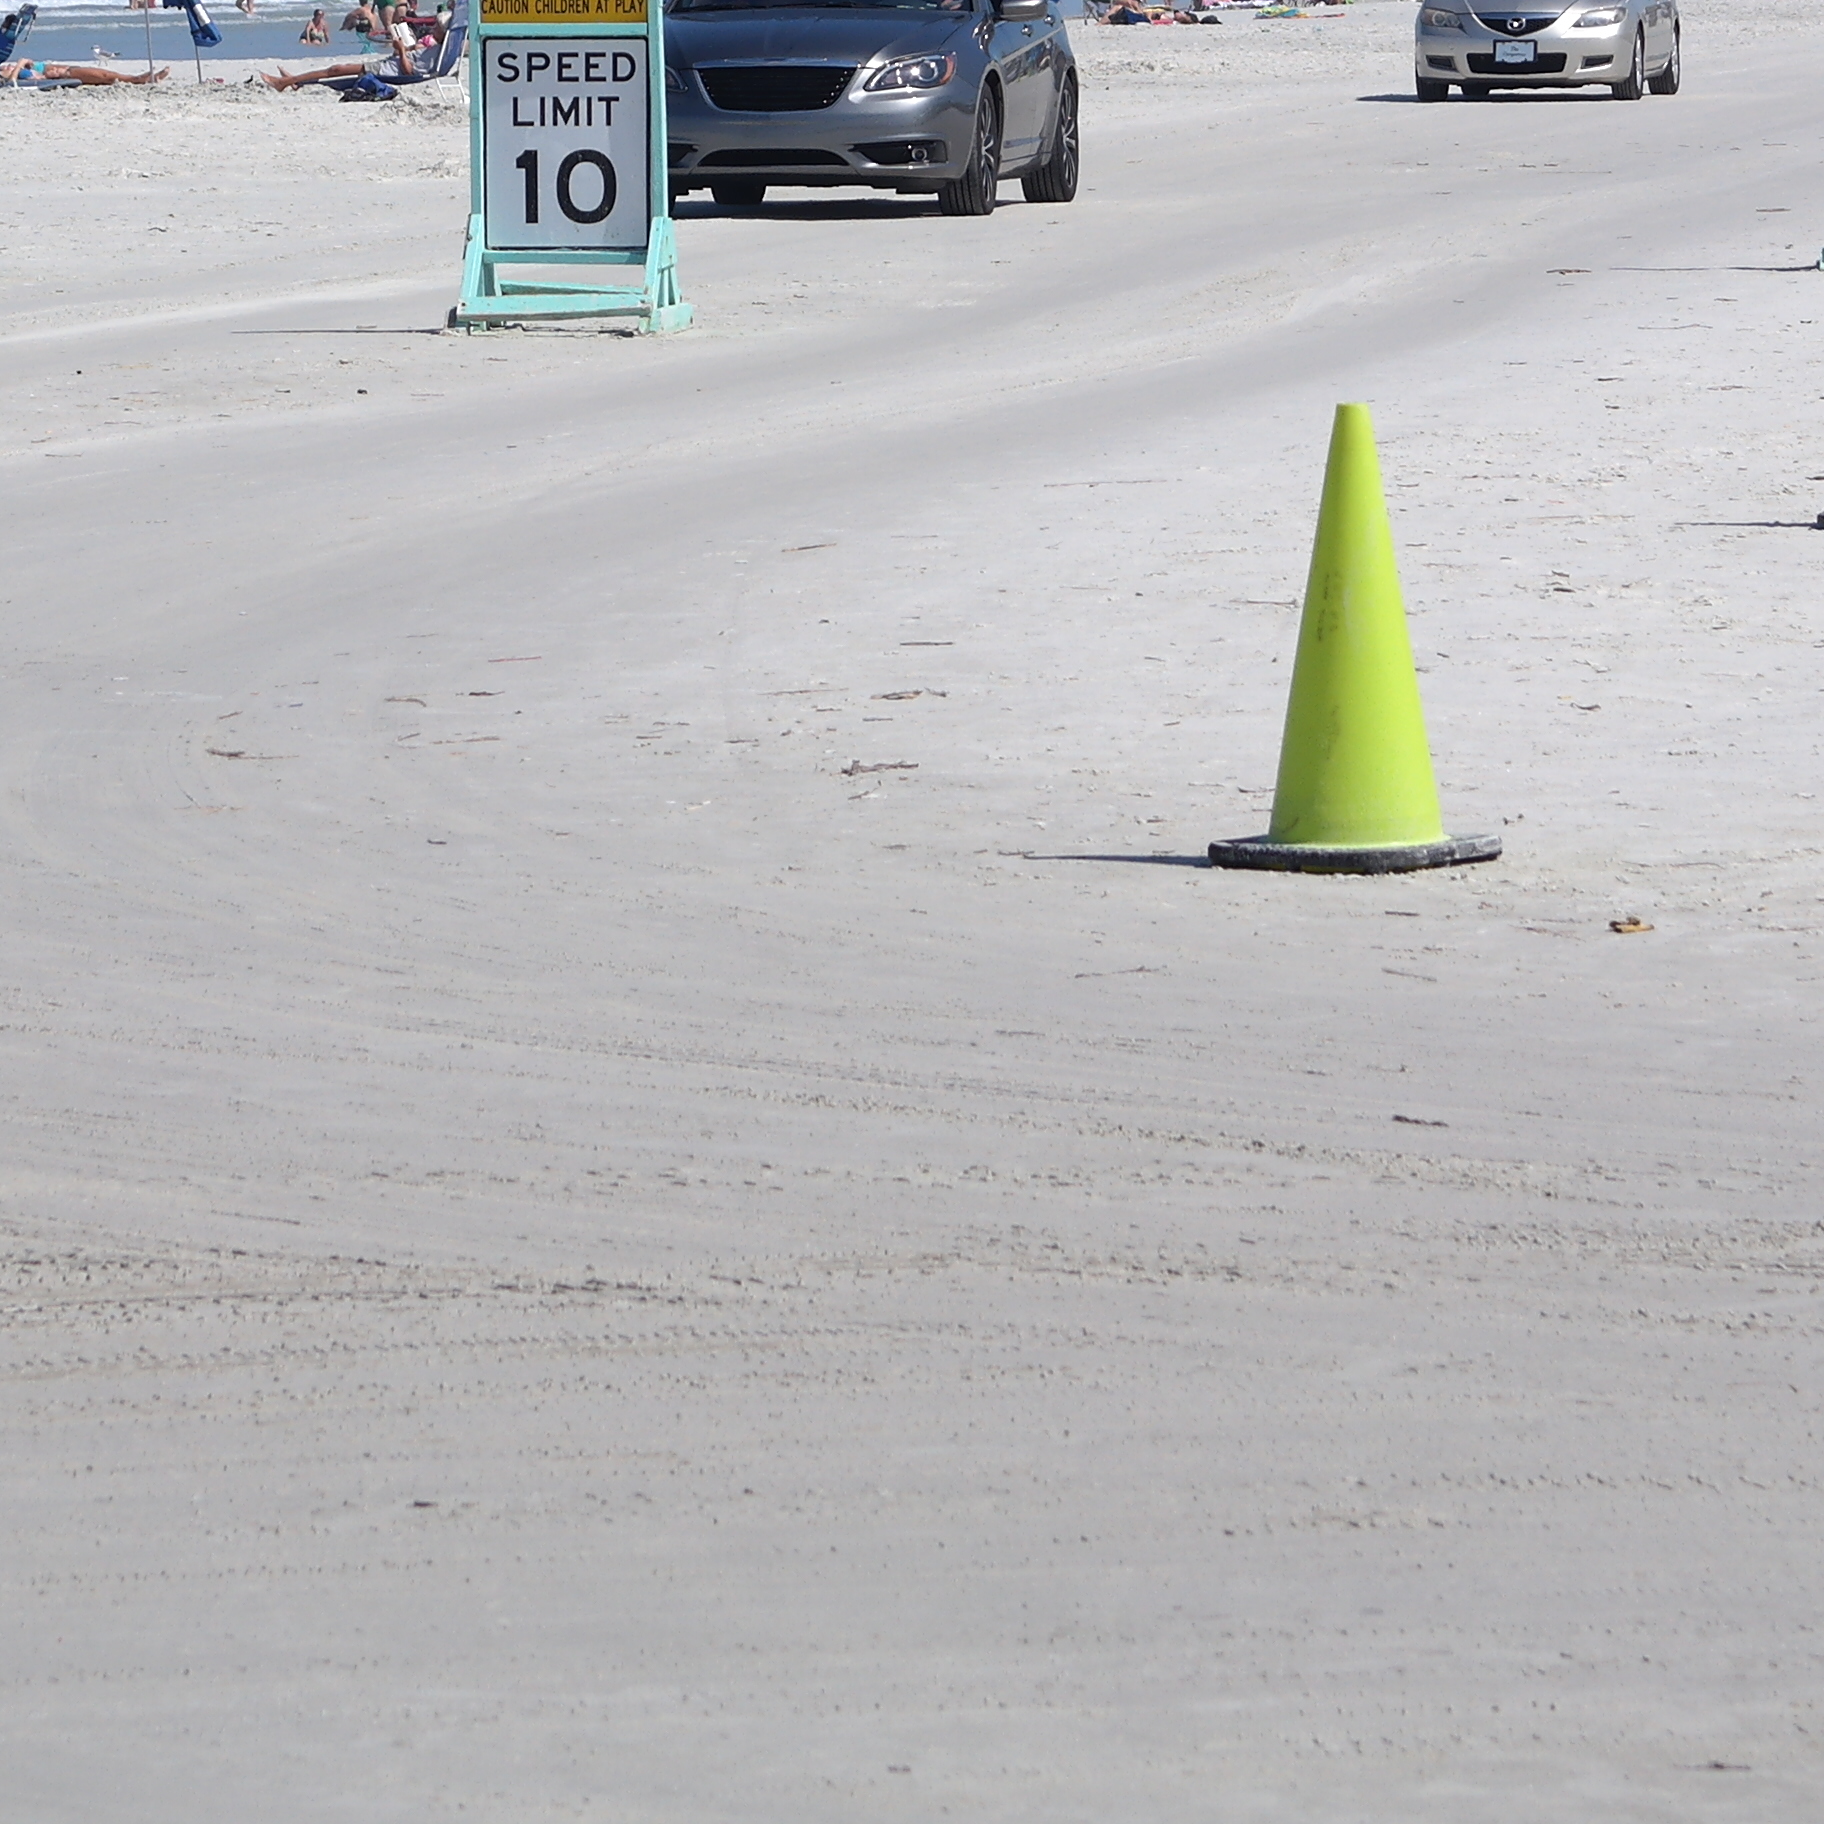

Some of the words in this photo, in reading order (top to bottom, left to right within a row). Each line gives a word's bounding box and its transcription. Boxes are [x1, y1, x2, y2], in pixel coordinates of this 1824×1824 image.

[497, 52, 636, 83] SPEED
[512, 96, 620, 127] LIMIT
[515, 148, 617, 224] 10
